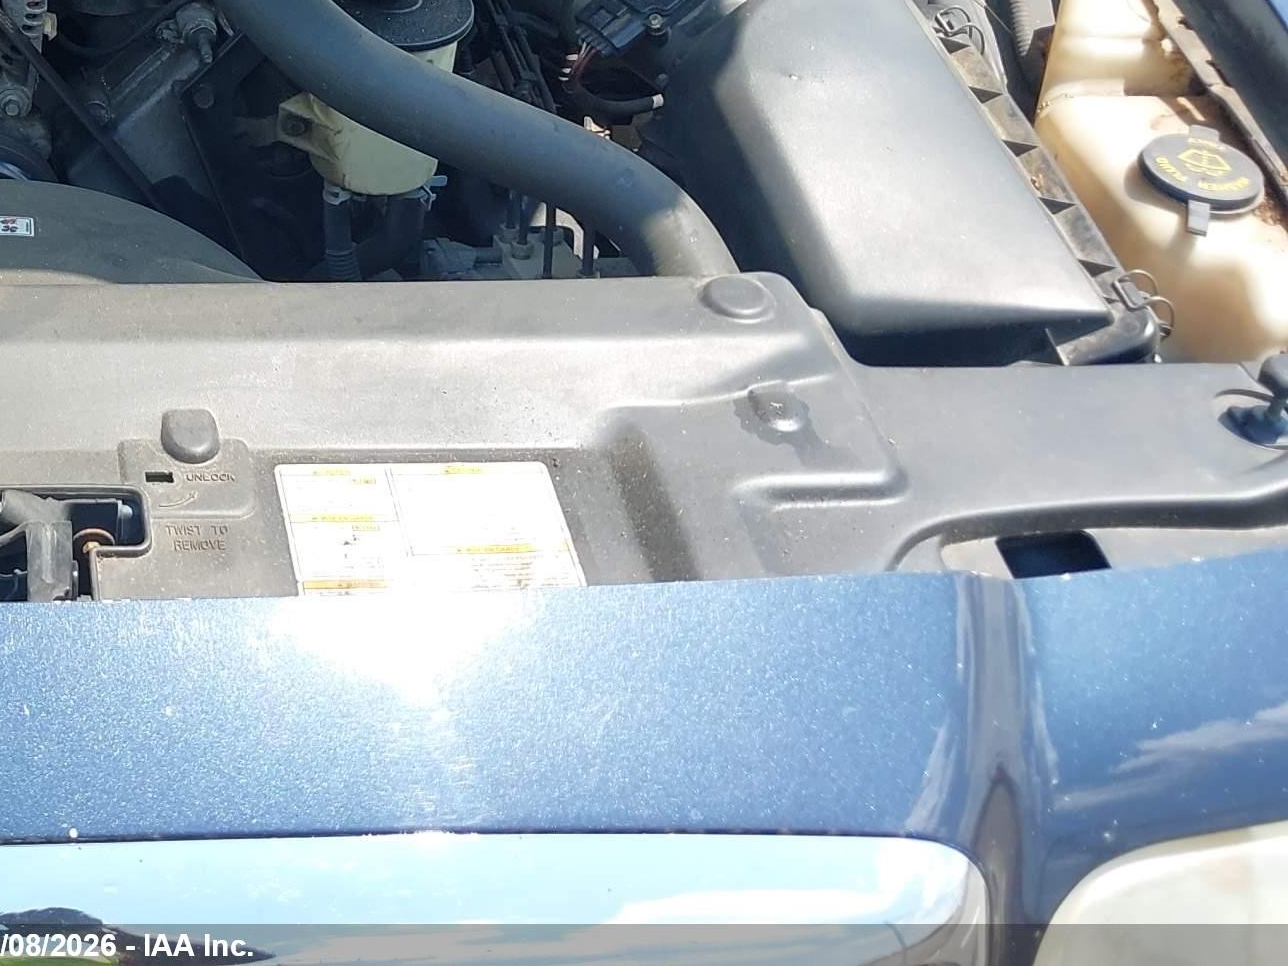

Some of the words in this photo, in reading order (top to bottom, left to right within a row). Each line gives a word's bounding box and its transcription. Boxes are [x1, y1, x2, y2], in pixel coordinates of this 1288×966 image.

[185, 473, 236, 482] UNLOCK
[166, 524, 201, 536] TWIST
[210, 524, 229, 536] TO
[173, 539, 227, 552] REMOVE
